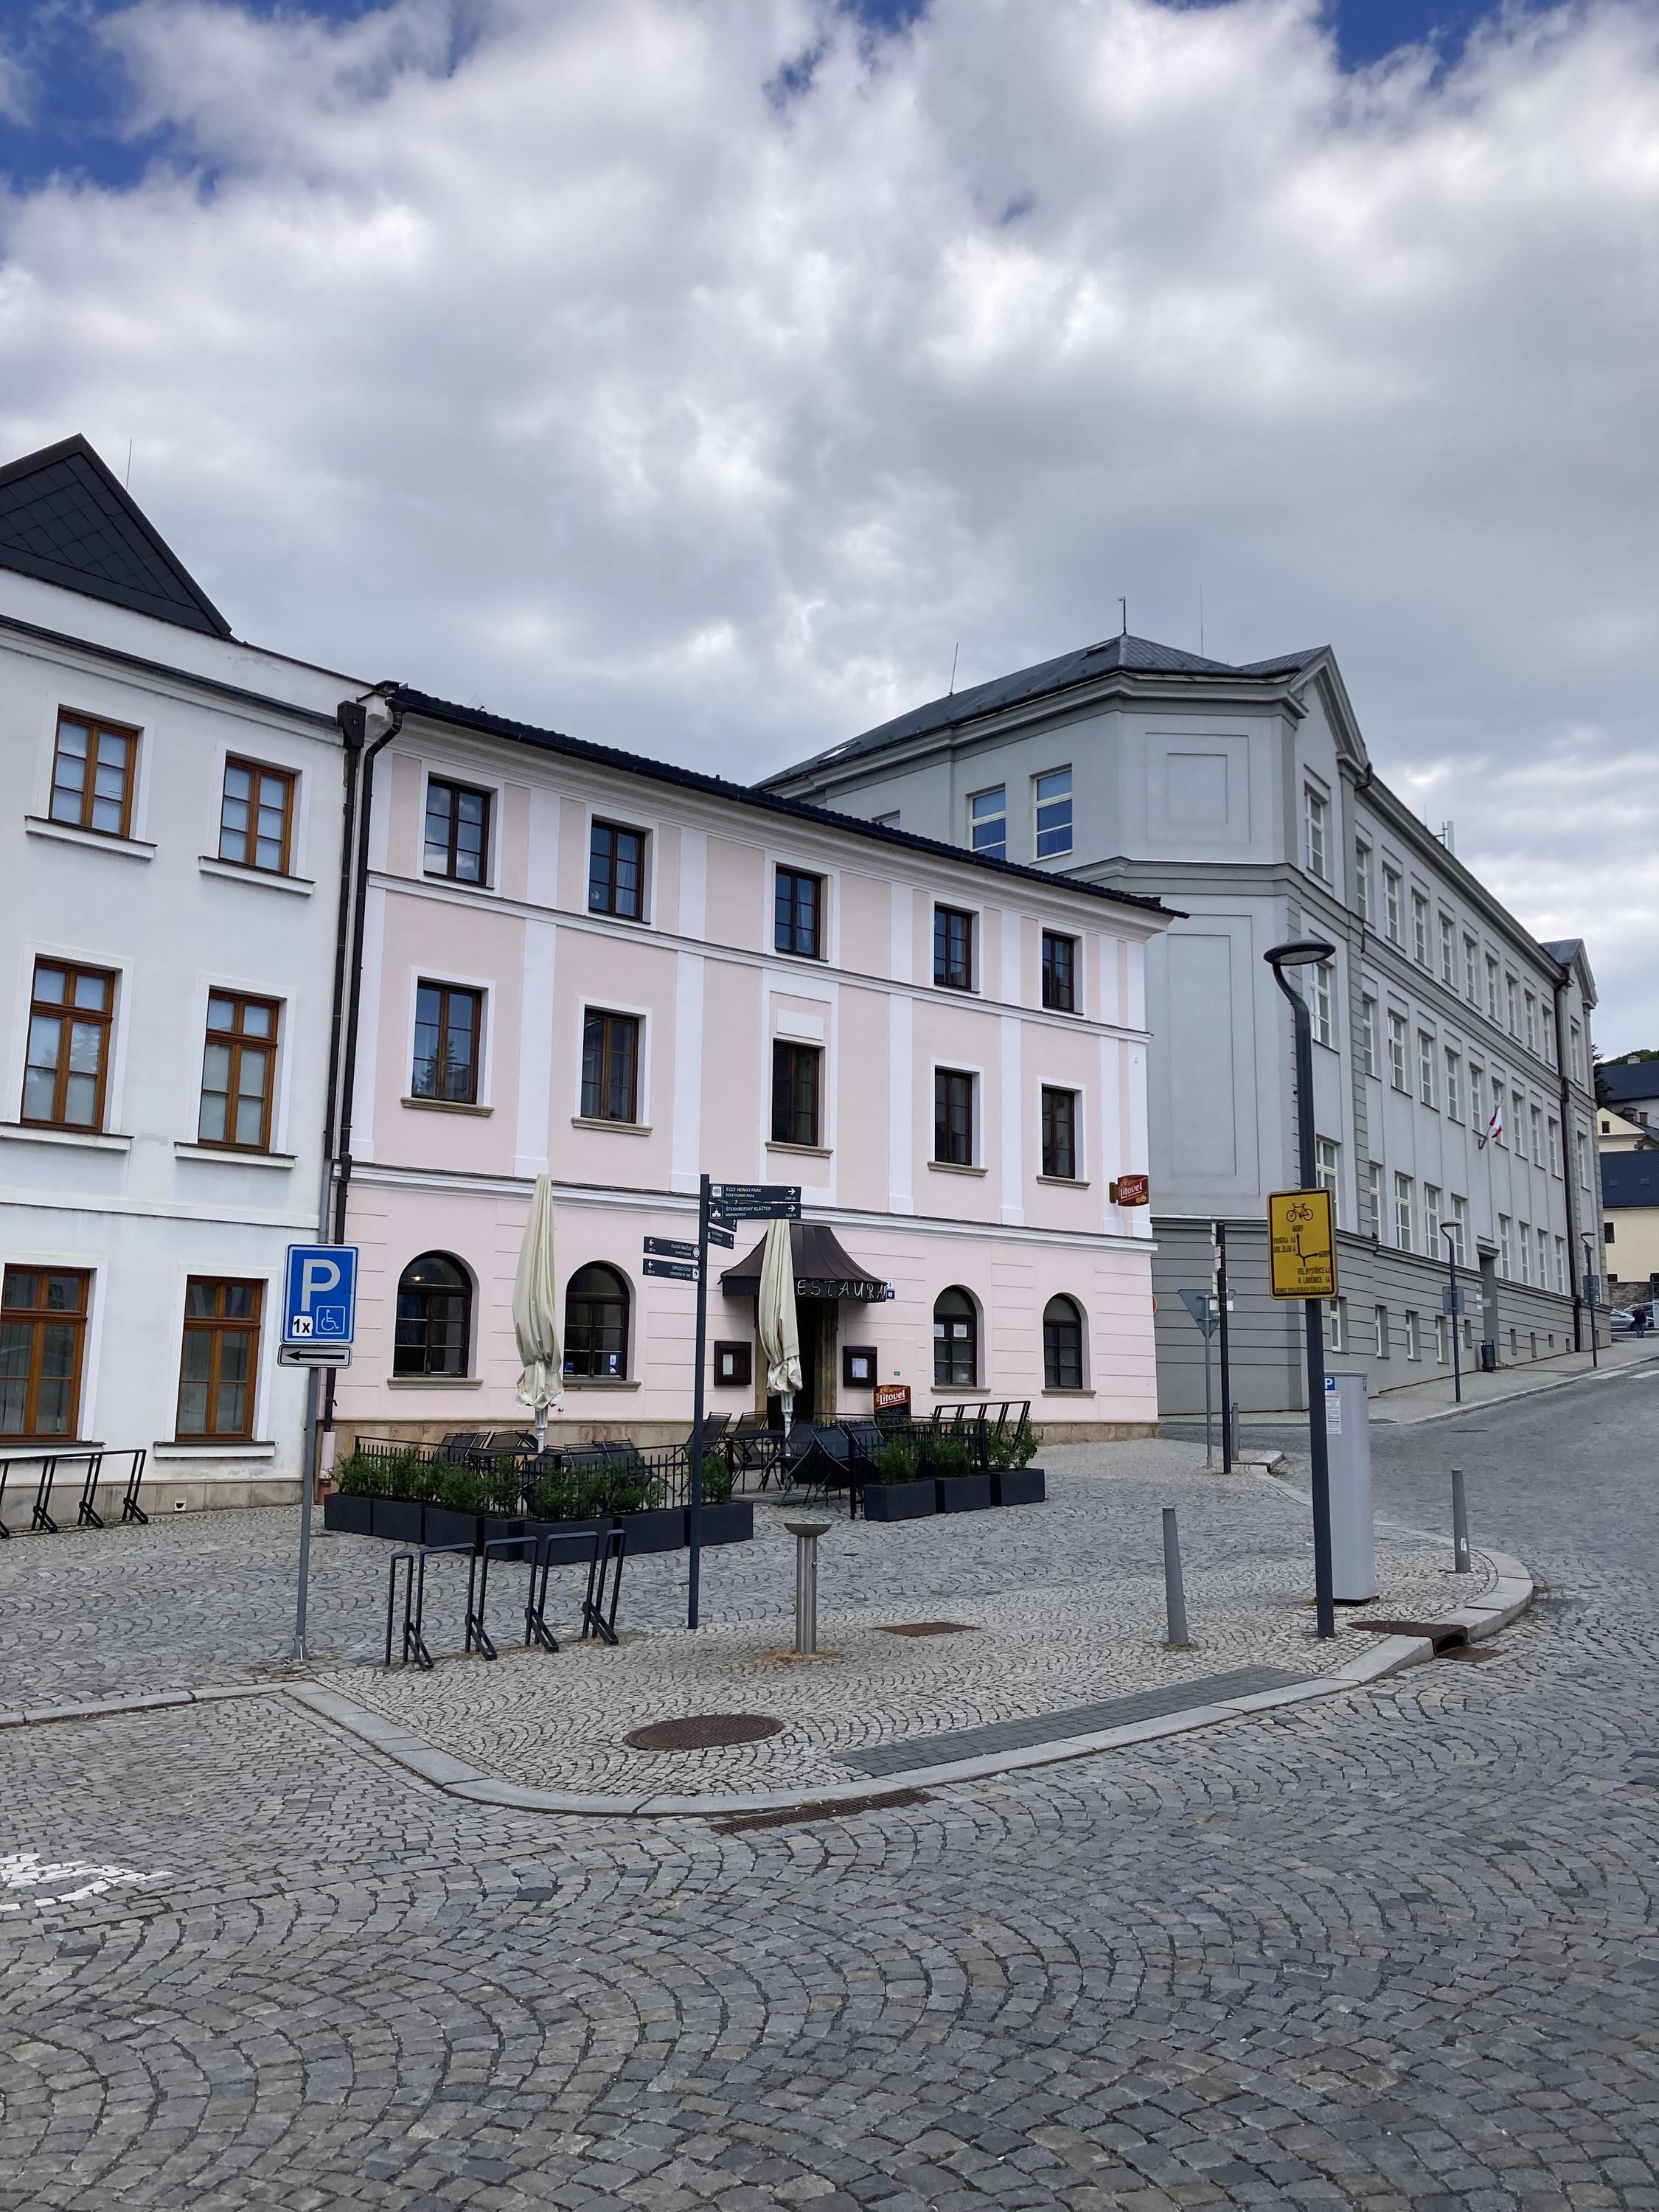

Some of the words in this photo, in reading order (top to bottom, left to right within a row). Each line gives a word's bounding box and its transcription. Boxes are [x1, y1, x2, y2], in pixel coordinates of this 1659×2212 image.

[1121, 1181, 1143, 1199] Litovel
[301, 1259, 341, 1312] P
[797, 1280, 886, 1299] ESTAURA
[294, 1318, 310, 1333] 1x
[1324, 1378, 1332, 1389] P
[880, 1389, 906, 1405] Litovel
